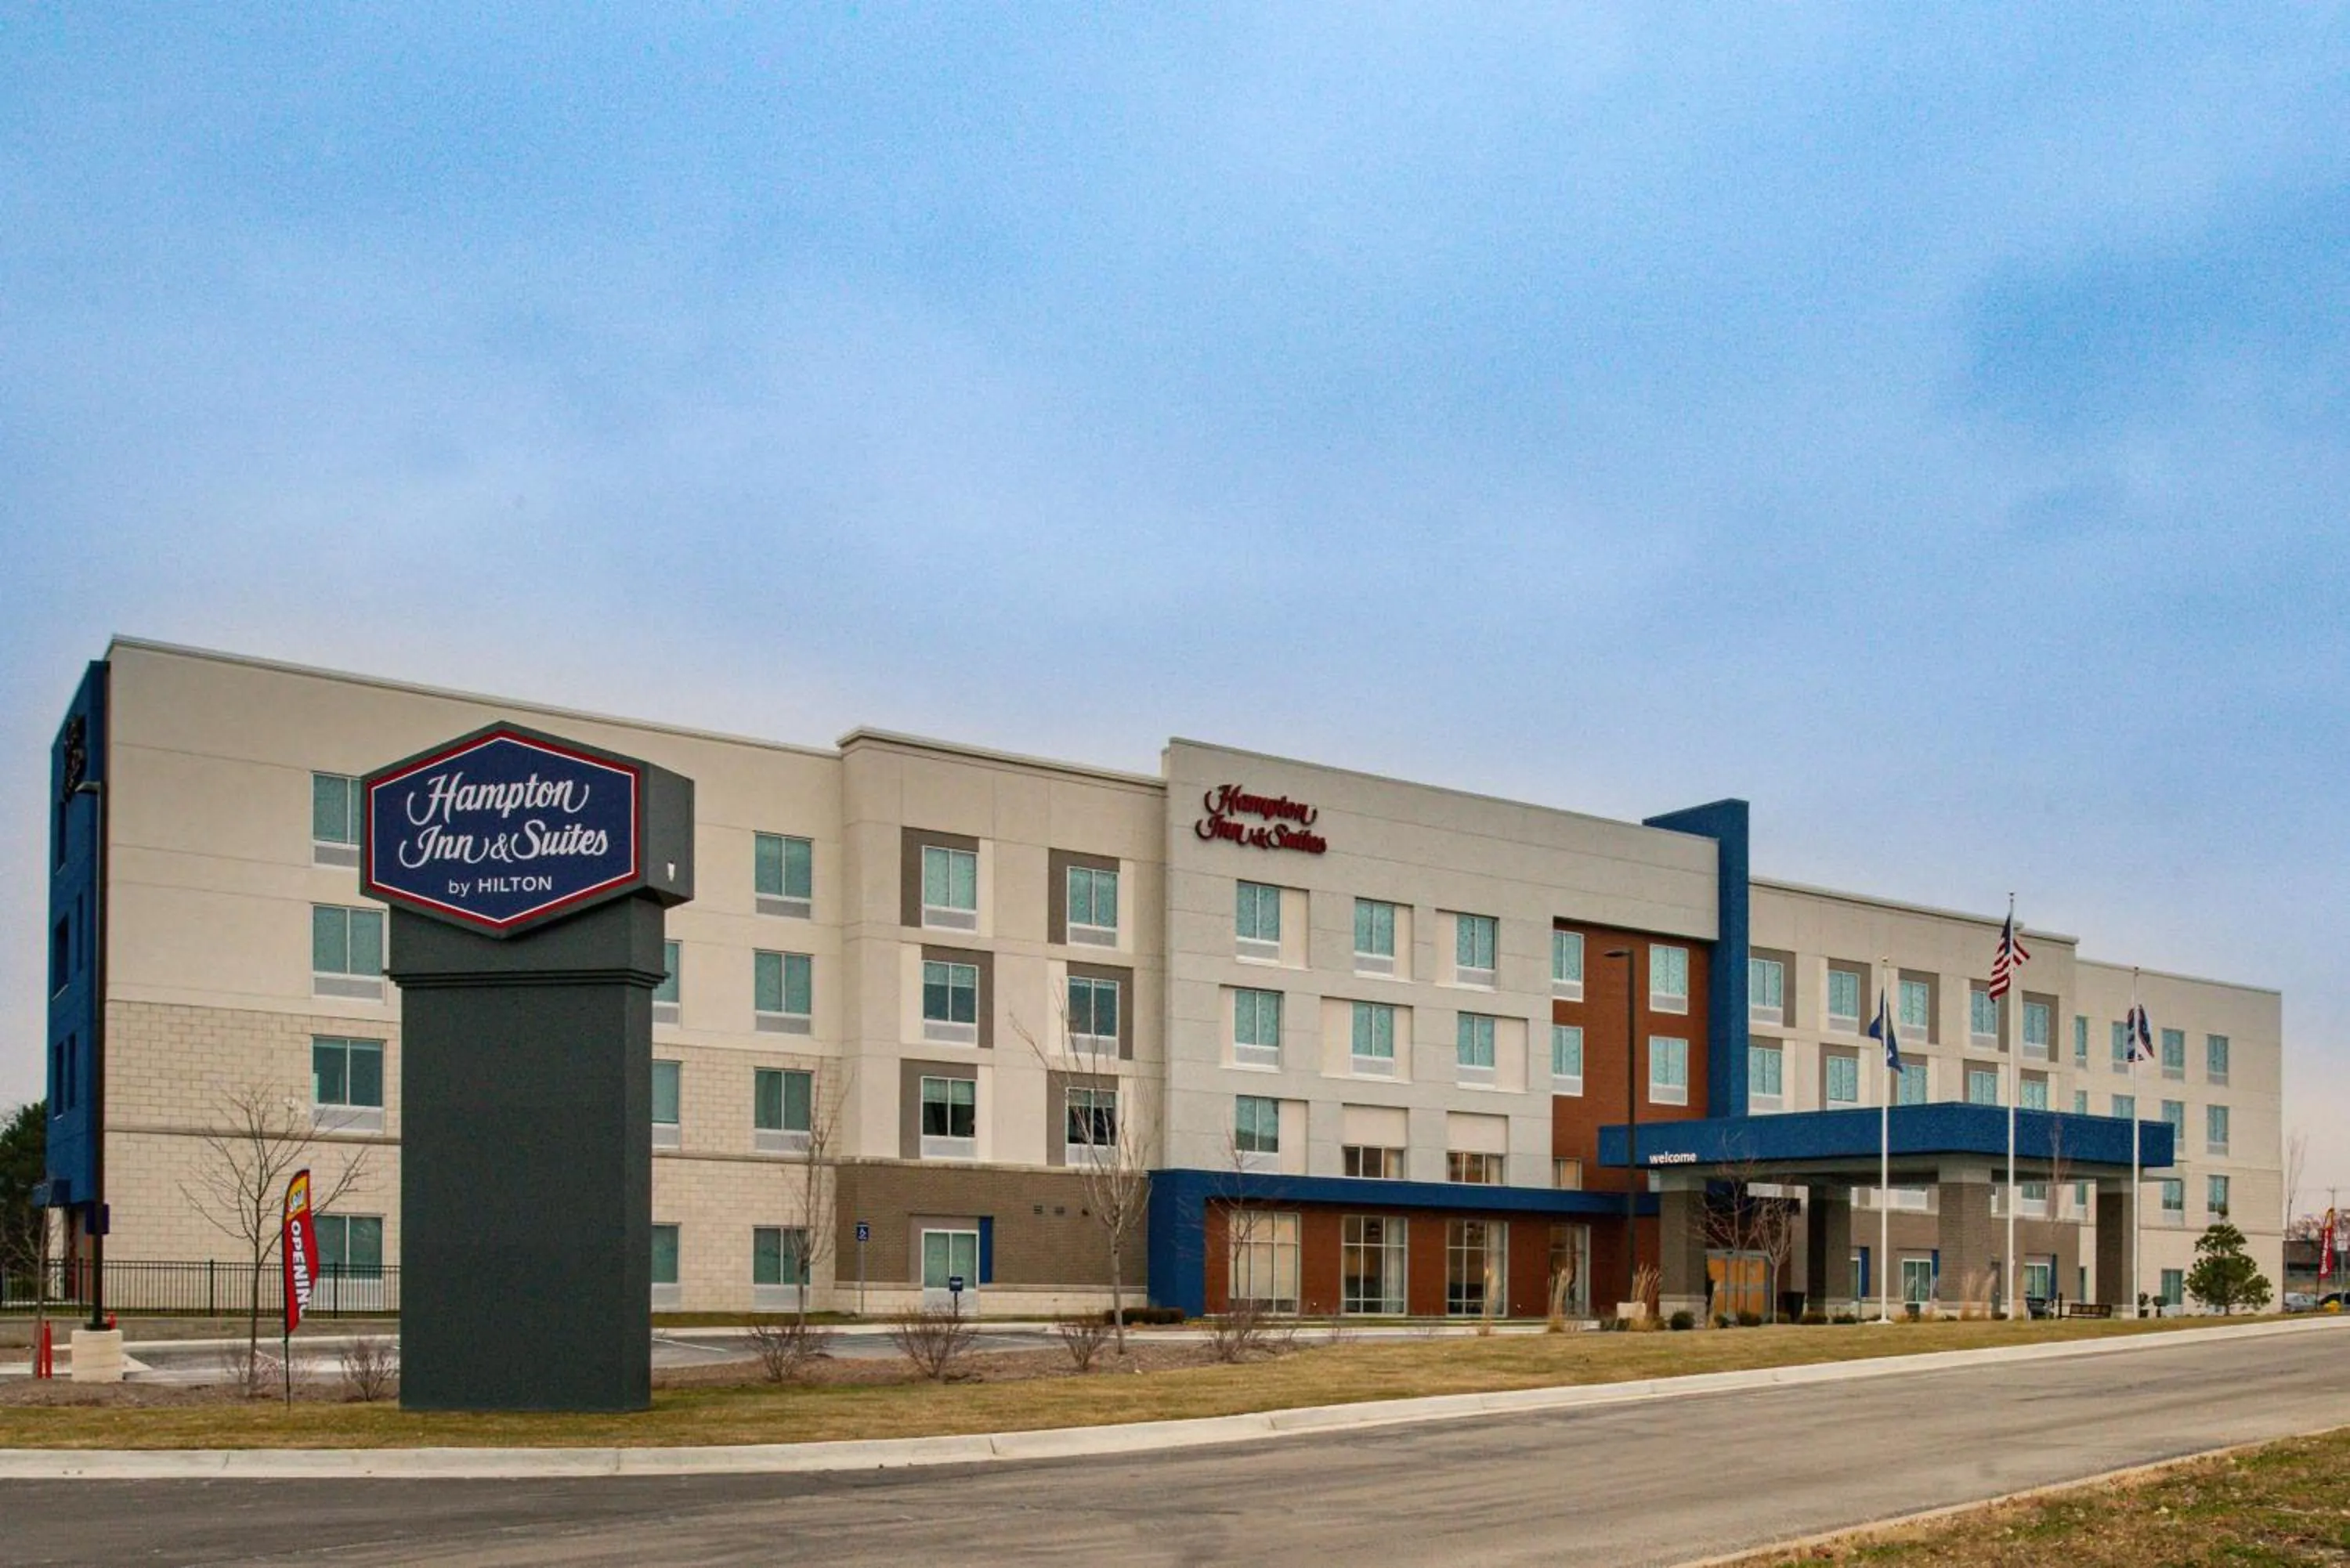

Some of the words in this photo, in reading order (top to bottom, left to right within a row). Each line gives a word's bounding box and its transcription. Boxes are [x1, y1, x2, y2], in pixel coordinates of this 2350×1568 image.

[407, 771, 589, 826] Hampton
[1204, 784, 1318, 826] Hampton
[399, 825, 490, 869] Inn
[511, 819, 609, 860] Suites
[1195, 815, 1253, 845] Inn
[1267, 823, 1327, 854] Suites
[448, 879, 470, 897] by
[478, 876, 552, 893] HILTON
[1648, 1150, 1697, 1165] welcome
